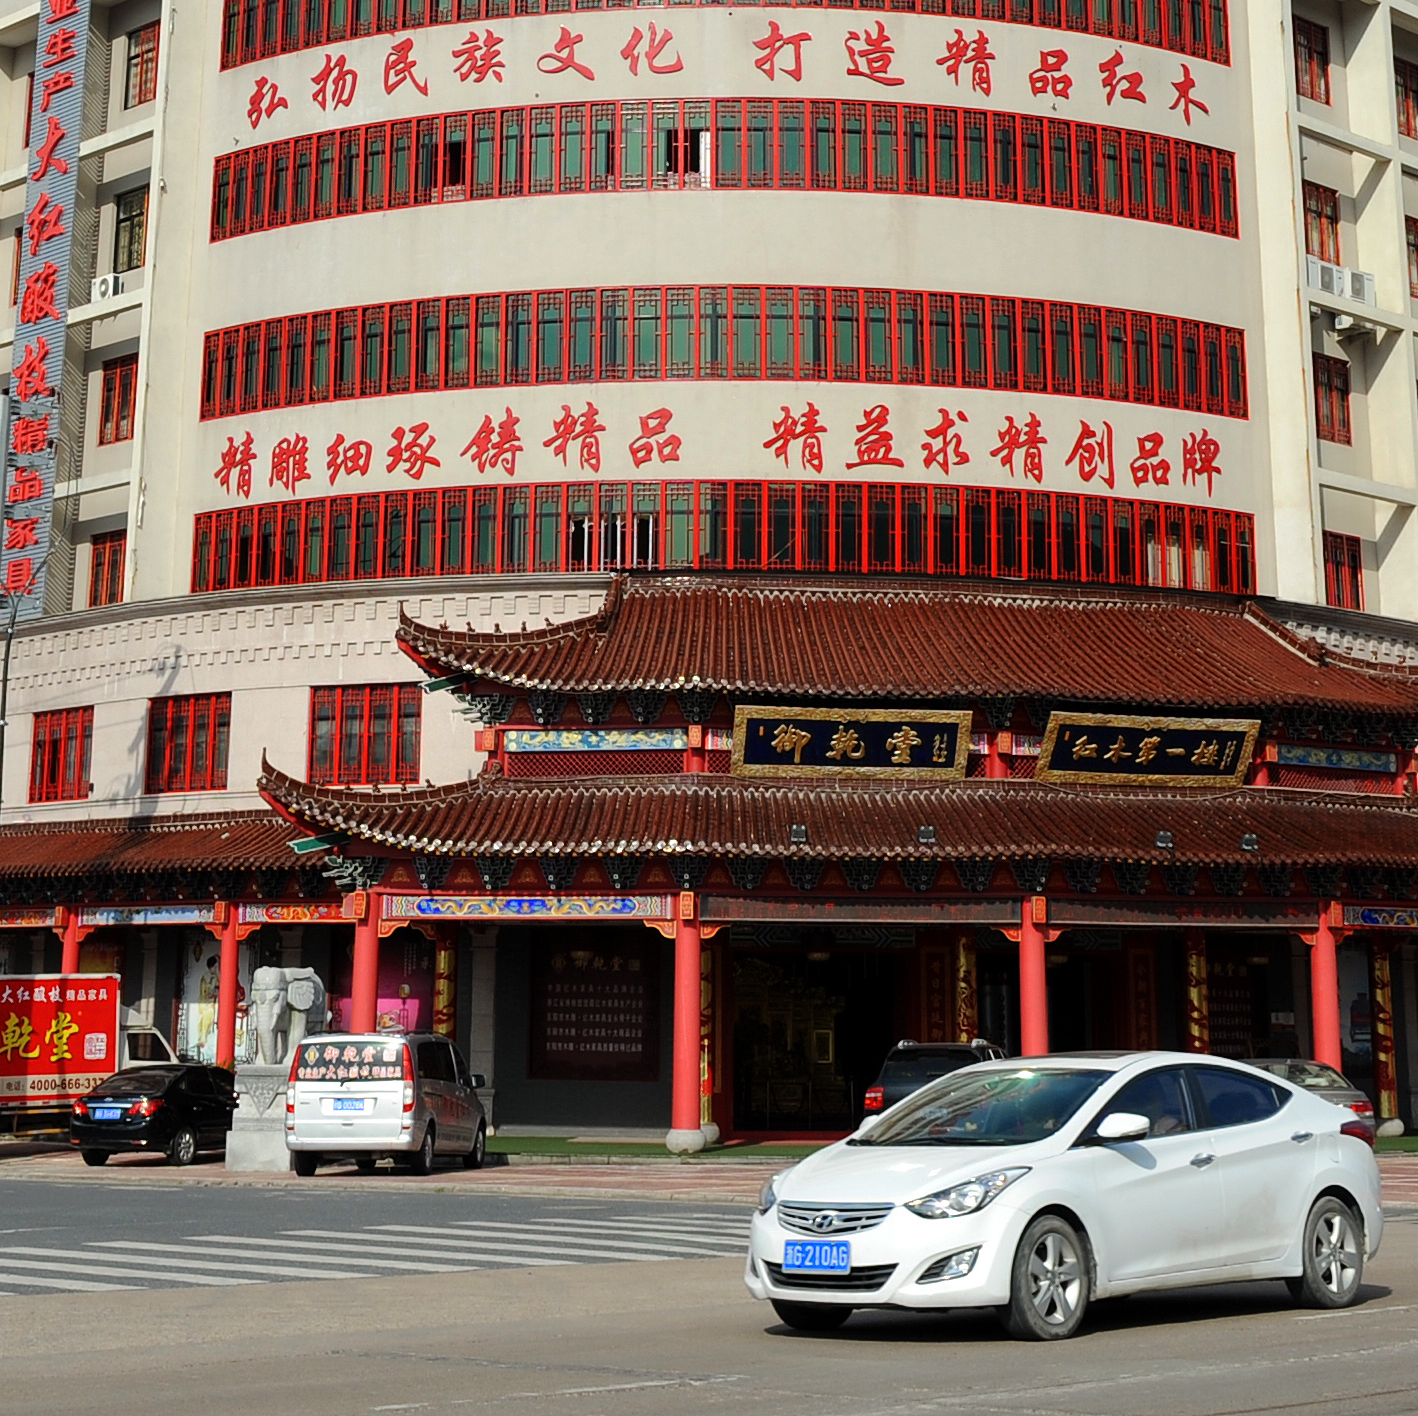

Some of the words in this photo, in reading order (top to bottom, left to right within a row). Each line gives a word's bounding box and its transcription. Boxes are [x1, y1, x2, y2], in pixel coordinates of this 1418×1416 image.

[249, 21, 683, 130] 弘扬民族文化
[752, 20, 1212, 127] 打造精品红木
[213, 402, 683, 500] 精雕细琢铸精品
[763, 400, 1222, 498] 精益求精创品牌
